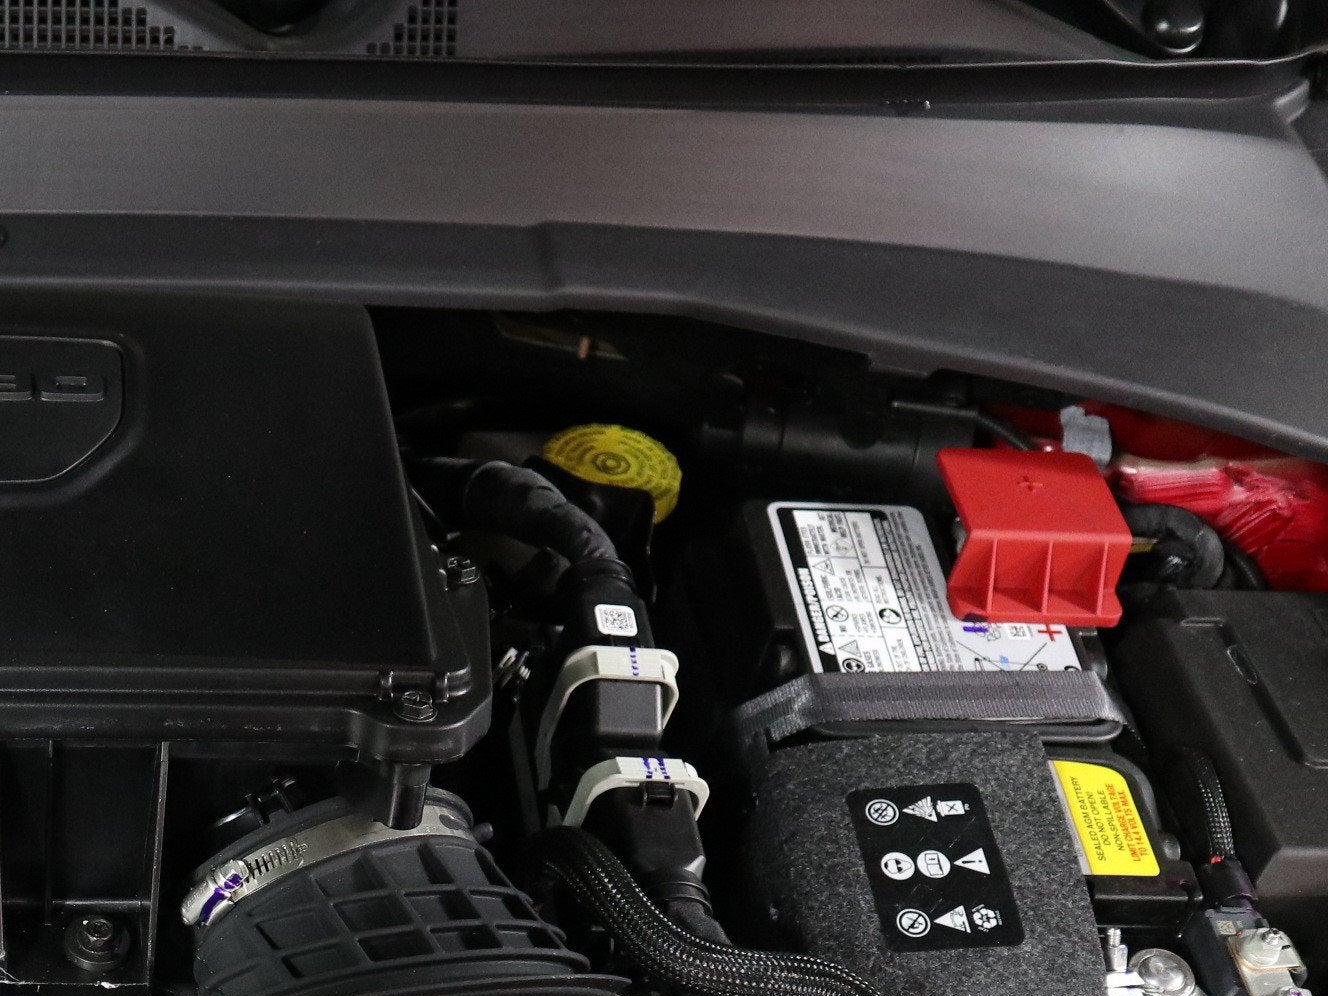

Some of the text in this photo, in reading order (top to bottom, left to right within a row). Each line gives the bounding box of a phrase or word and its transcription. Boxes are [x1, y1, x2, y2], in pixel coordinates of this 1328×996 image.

[1070, 777, 1106, 860] SEALED AGM BATTERY
[1086, 792, 1111, 845] DO NOT OPEN!
[1097, 791, 1124, 850] NON-SPILLABLE
[1105, 784, 1141, 861] LIMIT CHARGE VOLTAGE
[1124, 809, 1137, 829] VOLTS
[1132, 831, 1144, 845] 14.4
[1138, 847, 1148, 856] TO
